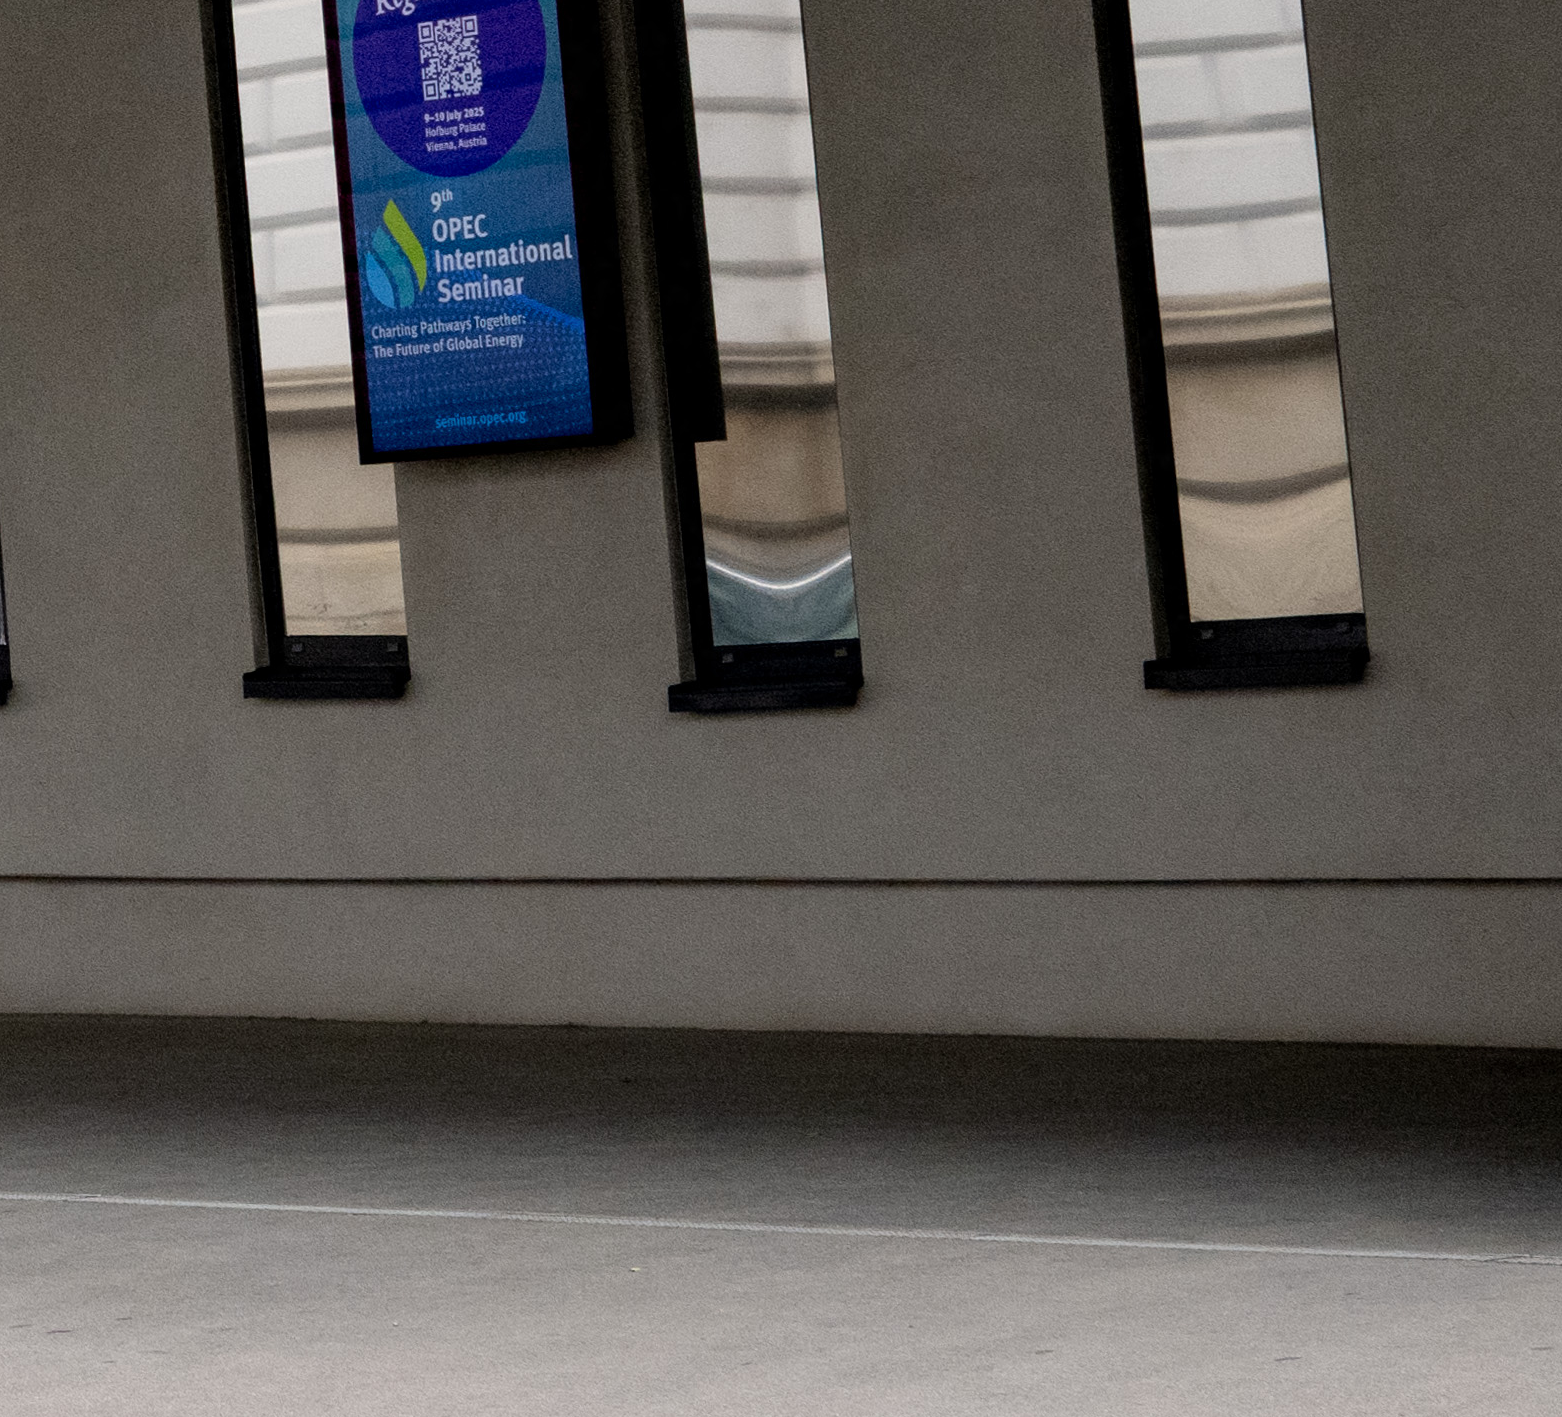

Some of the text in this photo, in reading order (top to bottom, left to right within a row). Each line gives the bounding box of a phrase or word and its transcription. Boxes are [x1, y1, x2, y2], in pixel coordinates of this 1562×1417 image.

[446, 108, 462, 122] July
[463, 106, 485, 118] 2025
[425, 120, 486, 138] Hofburg Palace
[458, 135, 487, 148] Austria
[431, 189, 454, 212] 9th
[432, 214, 488, 242] OPEC
[435, 234, 573, 273] International
[437, 274, 524, 303] Seminar
[371, 313, 527, 340] Charting Pathways Together:
[373, 333, 524, 359] The Future of Global Energy
[435, 409, 527, 429] seminar.opec.org
